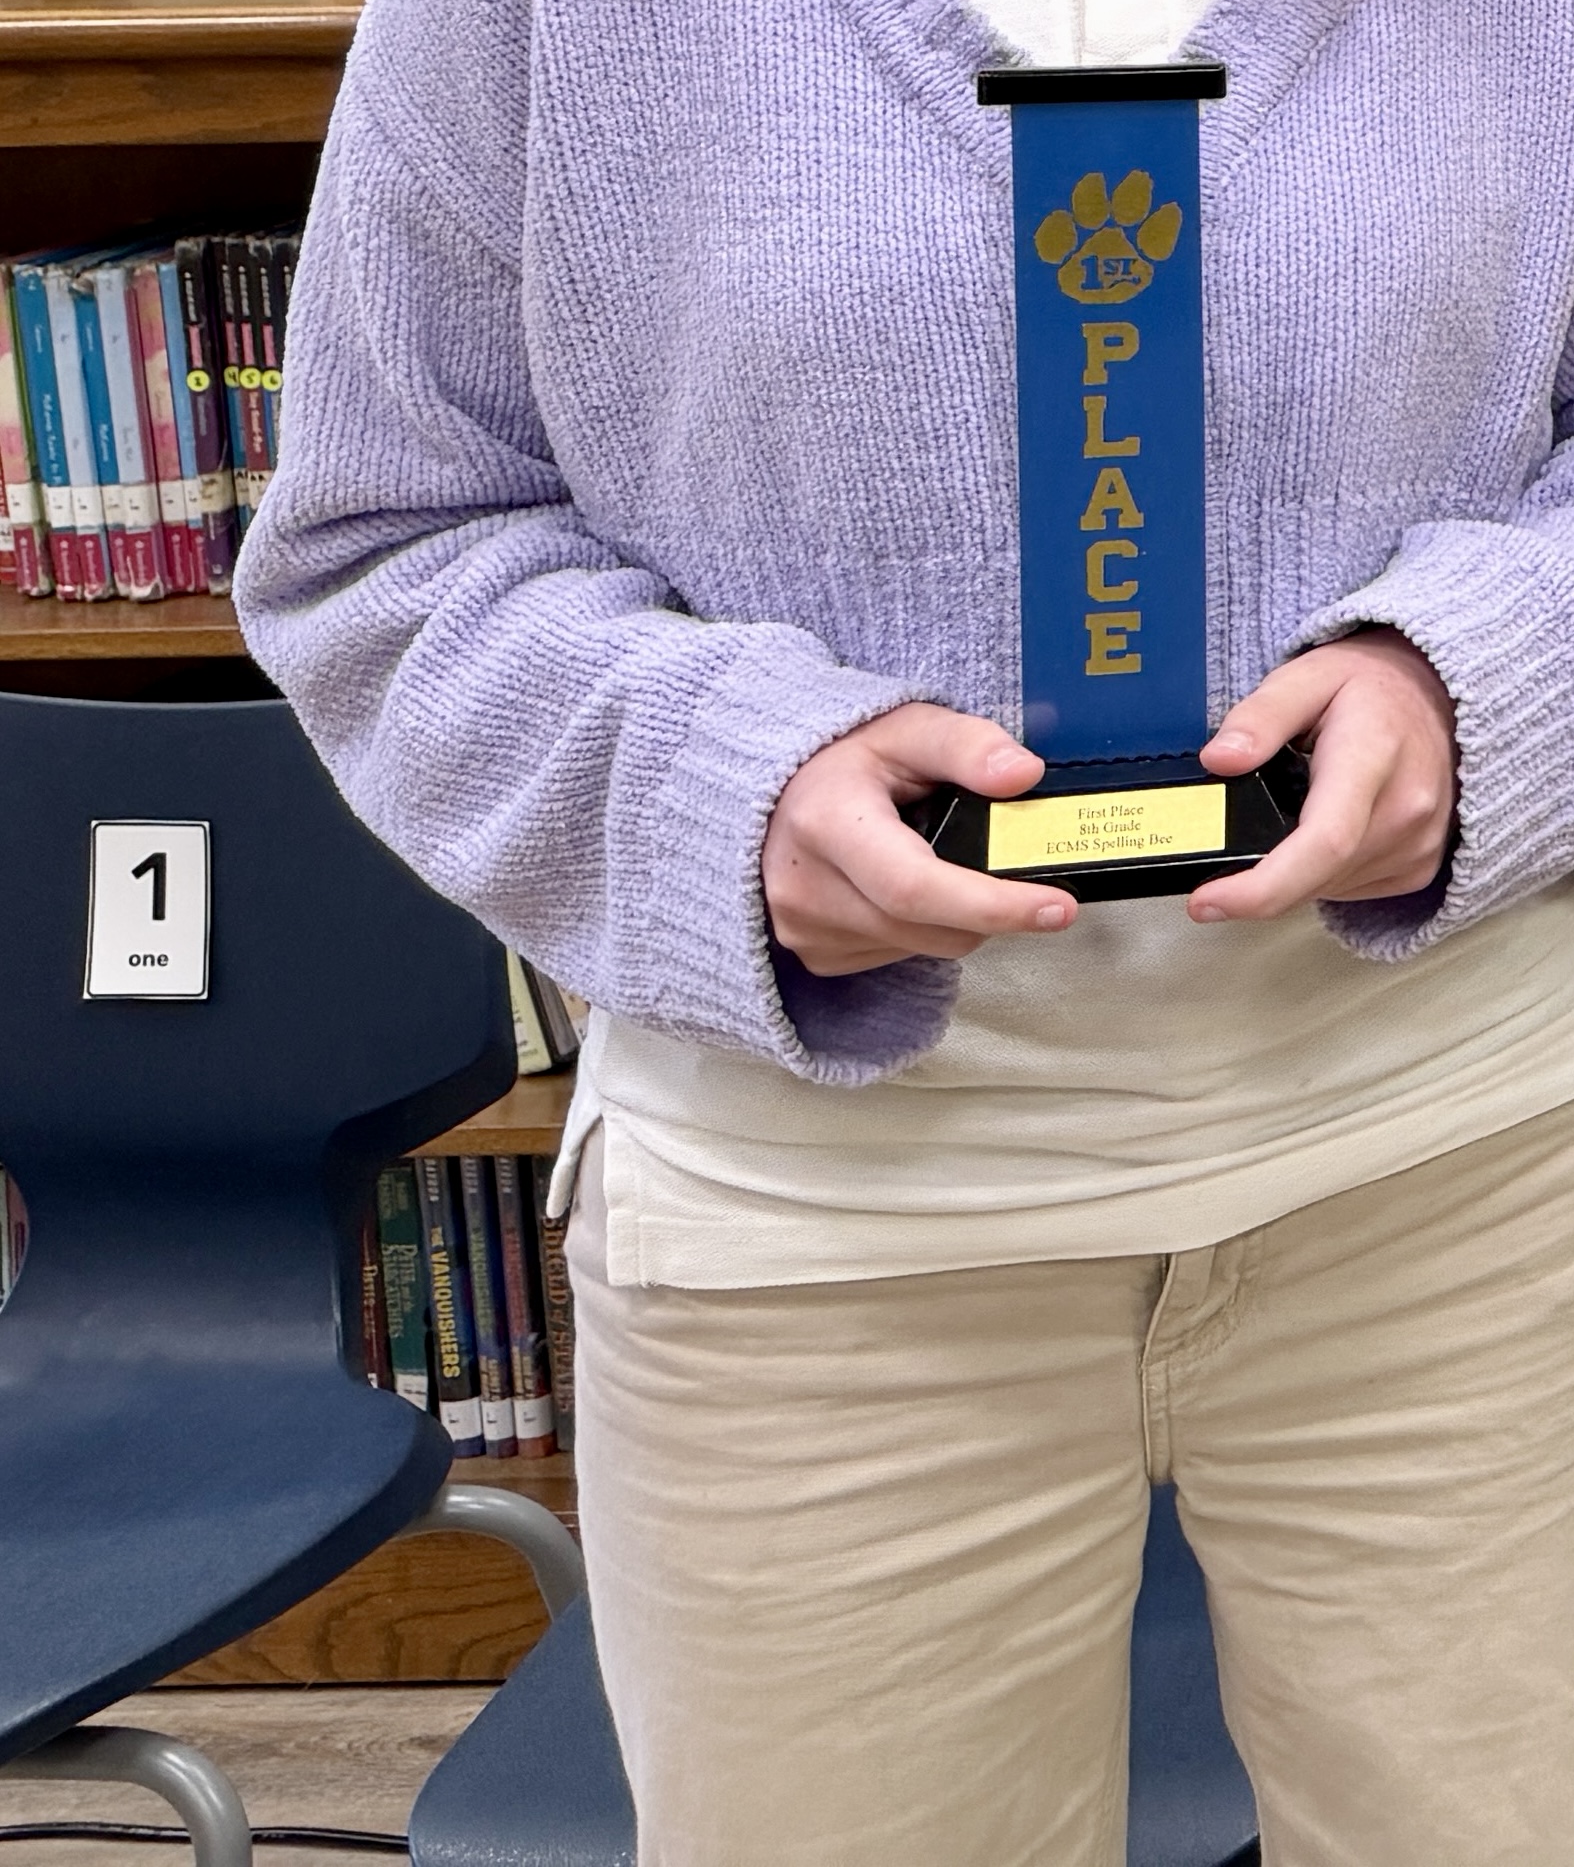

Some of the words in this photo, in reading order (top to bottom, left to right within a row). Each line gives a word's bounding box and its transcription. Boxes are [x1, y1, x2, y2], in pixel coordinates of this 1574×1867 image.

[1081, 254, 1139, 290] 1ST
[1081, 321, 1146, 677] PLACE
[1078, 807, 1106, 820] First
[1111, 805, 1144, 818] Place
[1079, 823, 1099, 836] 8th
[1103, 821, 1141, 834] Grade
[1046, 839, 1089, 855] ECMS
[1093, 836, 1145, 853] Spelling
[1149, 834, 1173, 846] Bee
[131, 852, 167, 921] 1
[128, 954, 169, 967] one
[430, 1250, 461, 1378] VANQUISHERS
